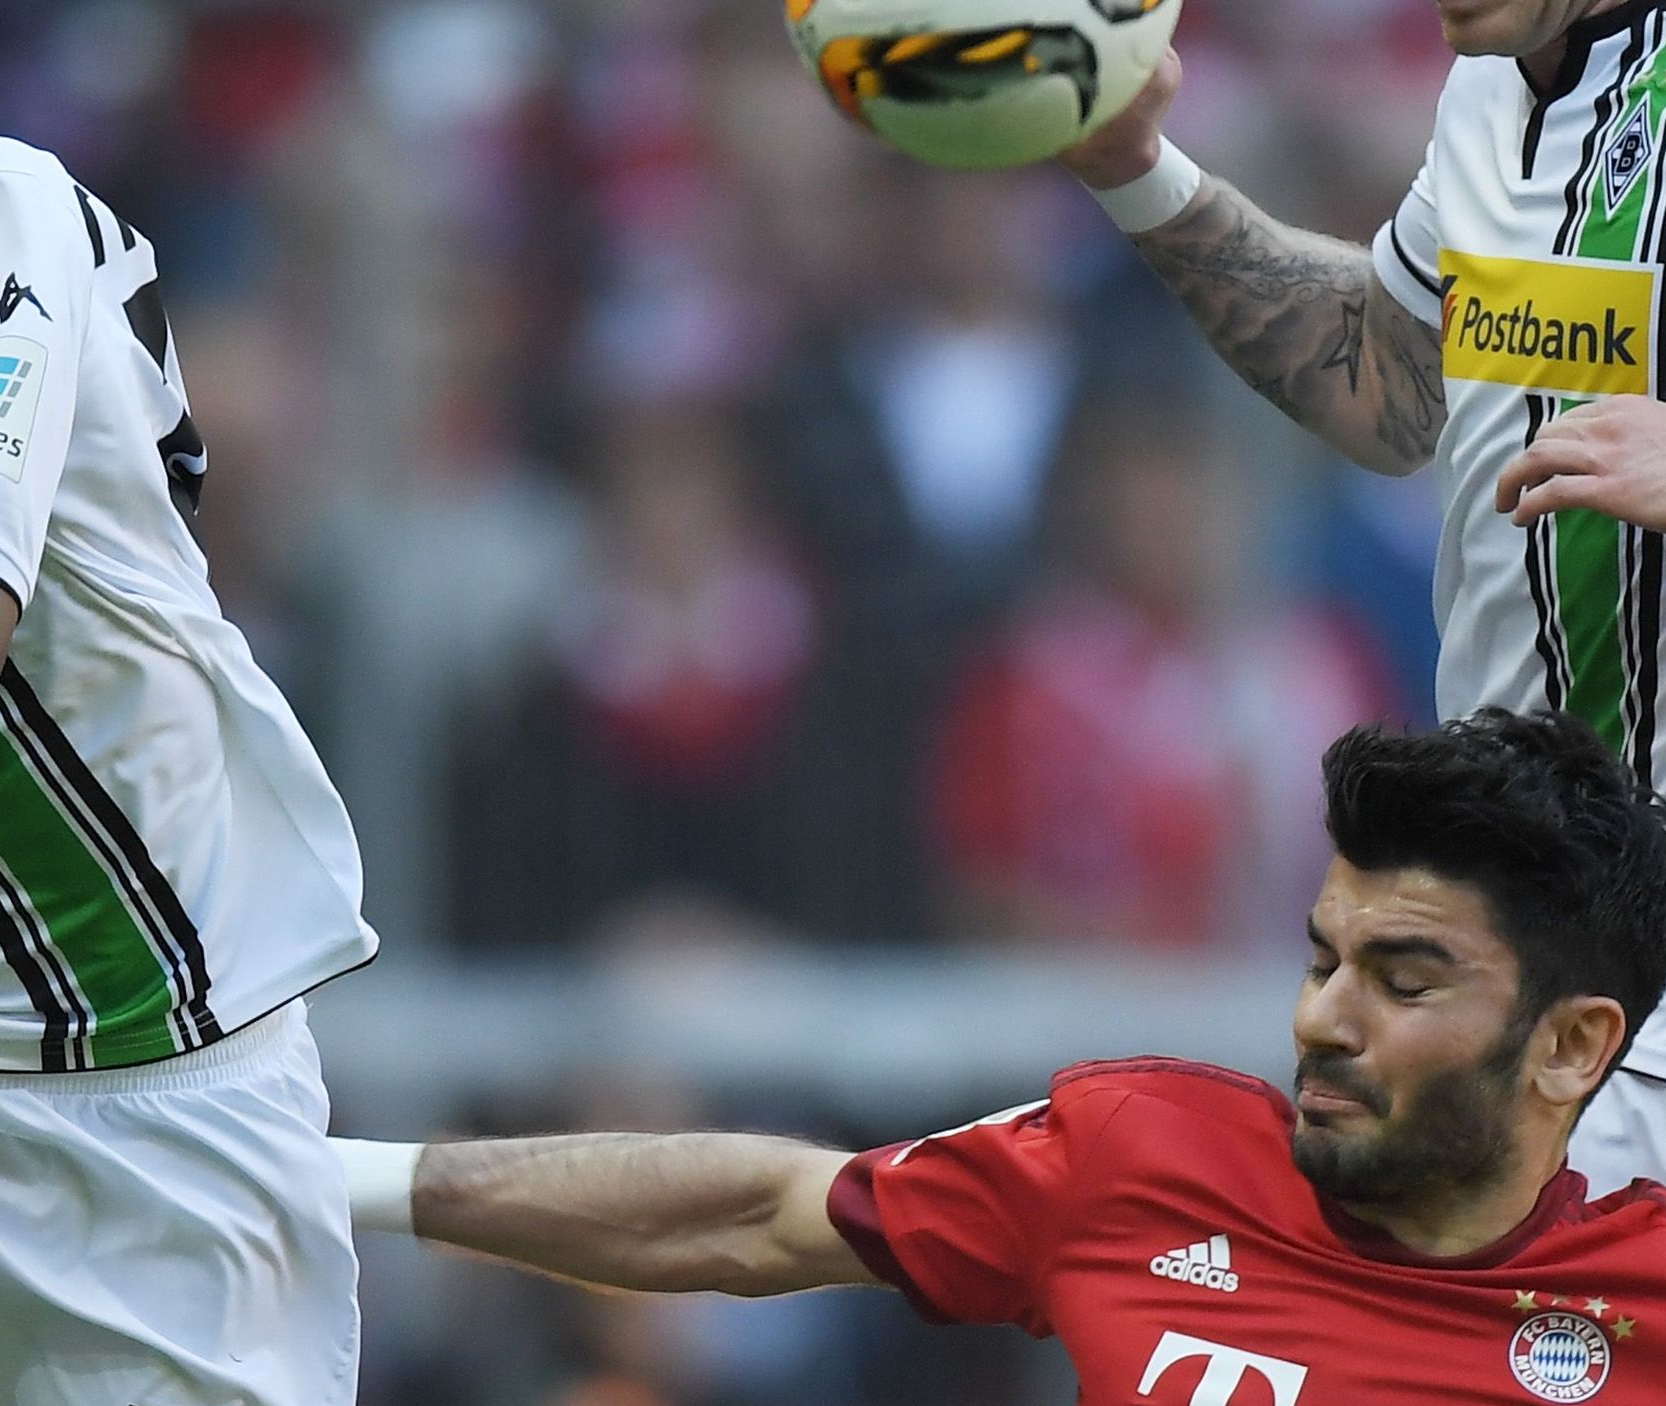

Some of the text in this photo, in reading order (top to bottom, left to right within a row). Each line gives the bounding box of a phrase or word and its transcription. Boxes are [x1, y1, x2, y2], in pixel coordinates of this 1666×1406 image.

[1458, 296, 1638, 366] Postbank
[1149, 1254, 1240, 1293] adidas
[1522, 1320, 1545, 1343] FC
[1547, 1316, 1606, 1366] BAYERN
